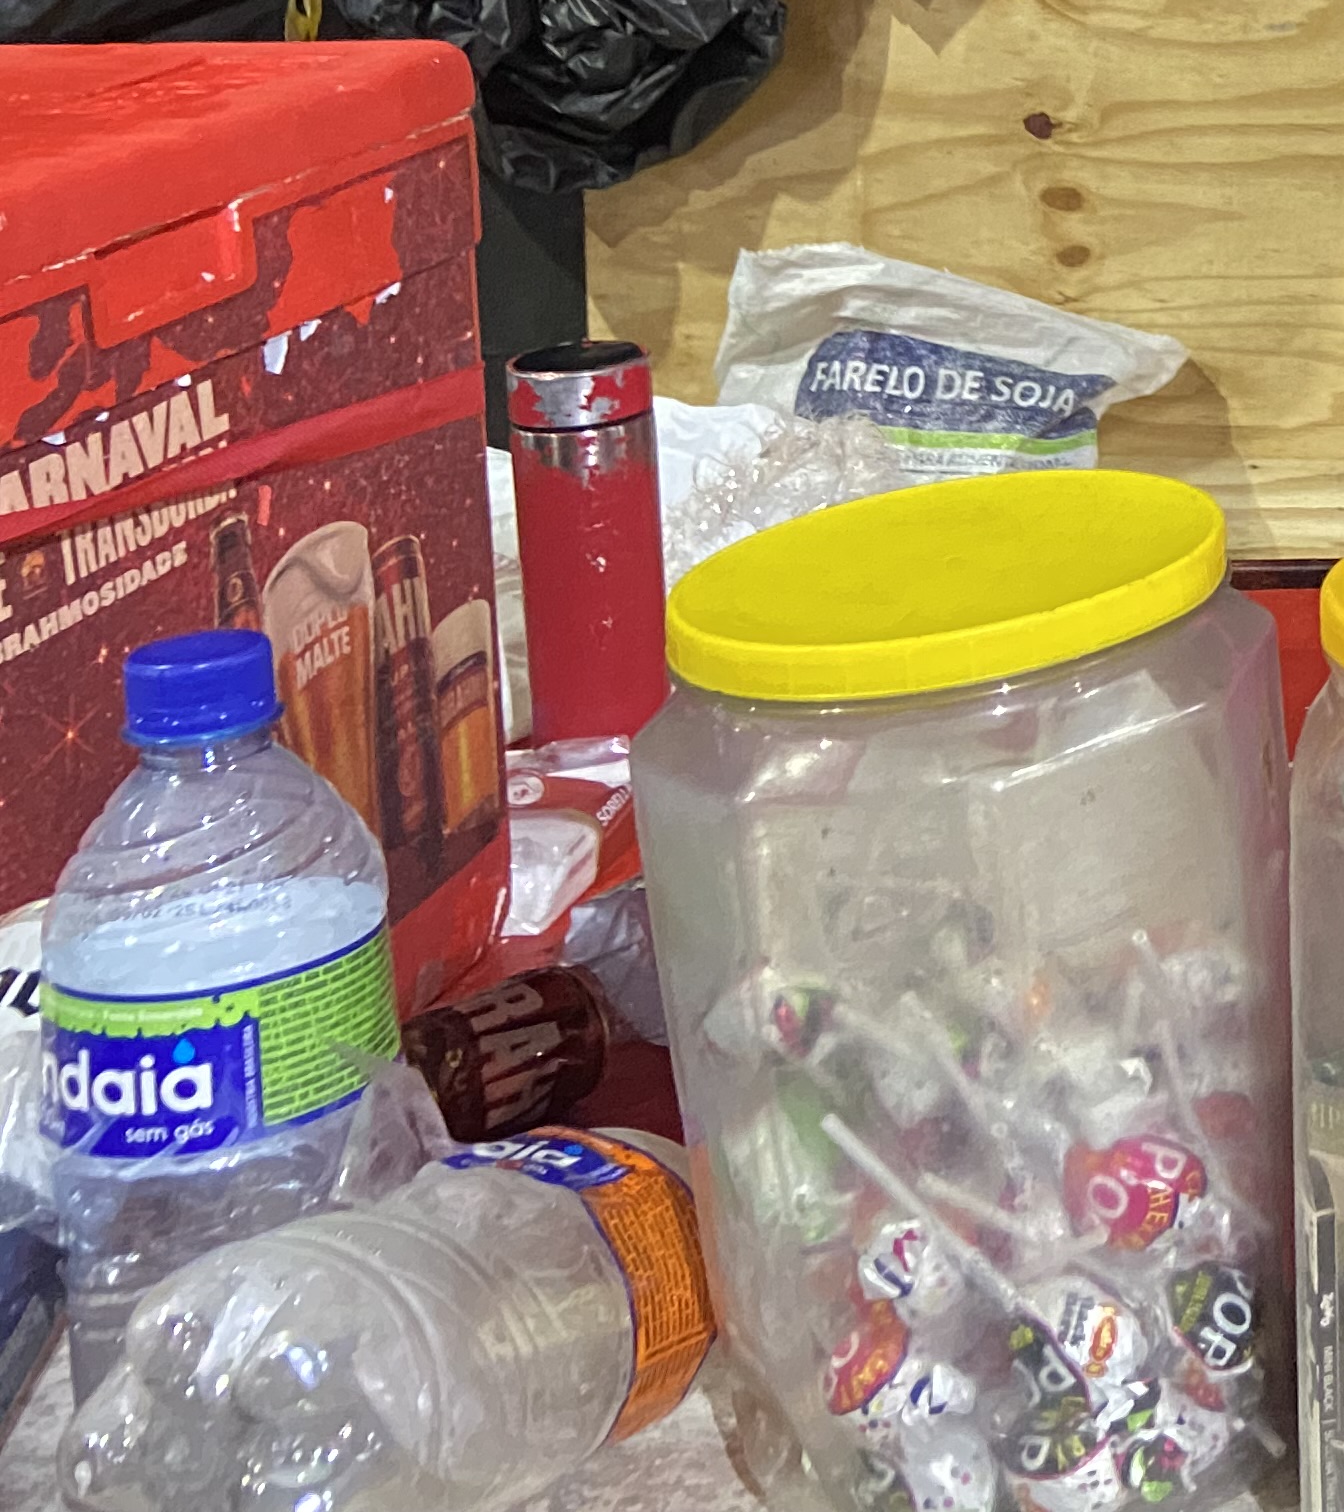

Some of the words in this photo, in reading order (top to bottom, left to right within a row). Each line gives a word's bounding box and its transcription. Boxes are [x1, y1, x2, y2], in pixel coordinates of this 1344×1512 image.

[808, 359, 926, 399] FARELO
[934, 368, 985, 401] DE
[989, 375, 1077, 418] SOJA
[295, 625, 351, 691] MALTE
[124, 1124, 168, 1144] sem
[173, 1117, 216, 1143] gás
[1322, 1345, 1335, 1373] MINI
[1322, 1374, 1335, 1412] BLACK
